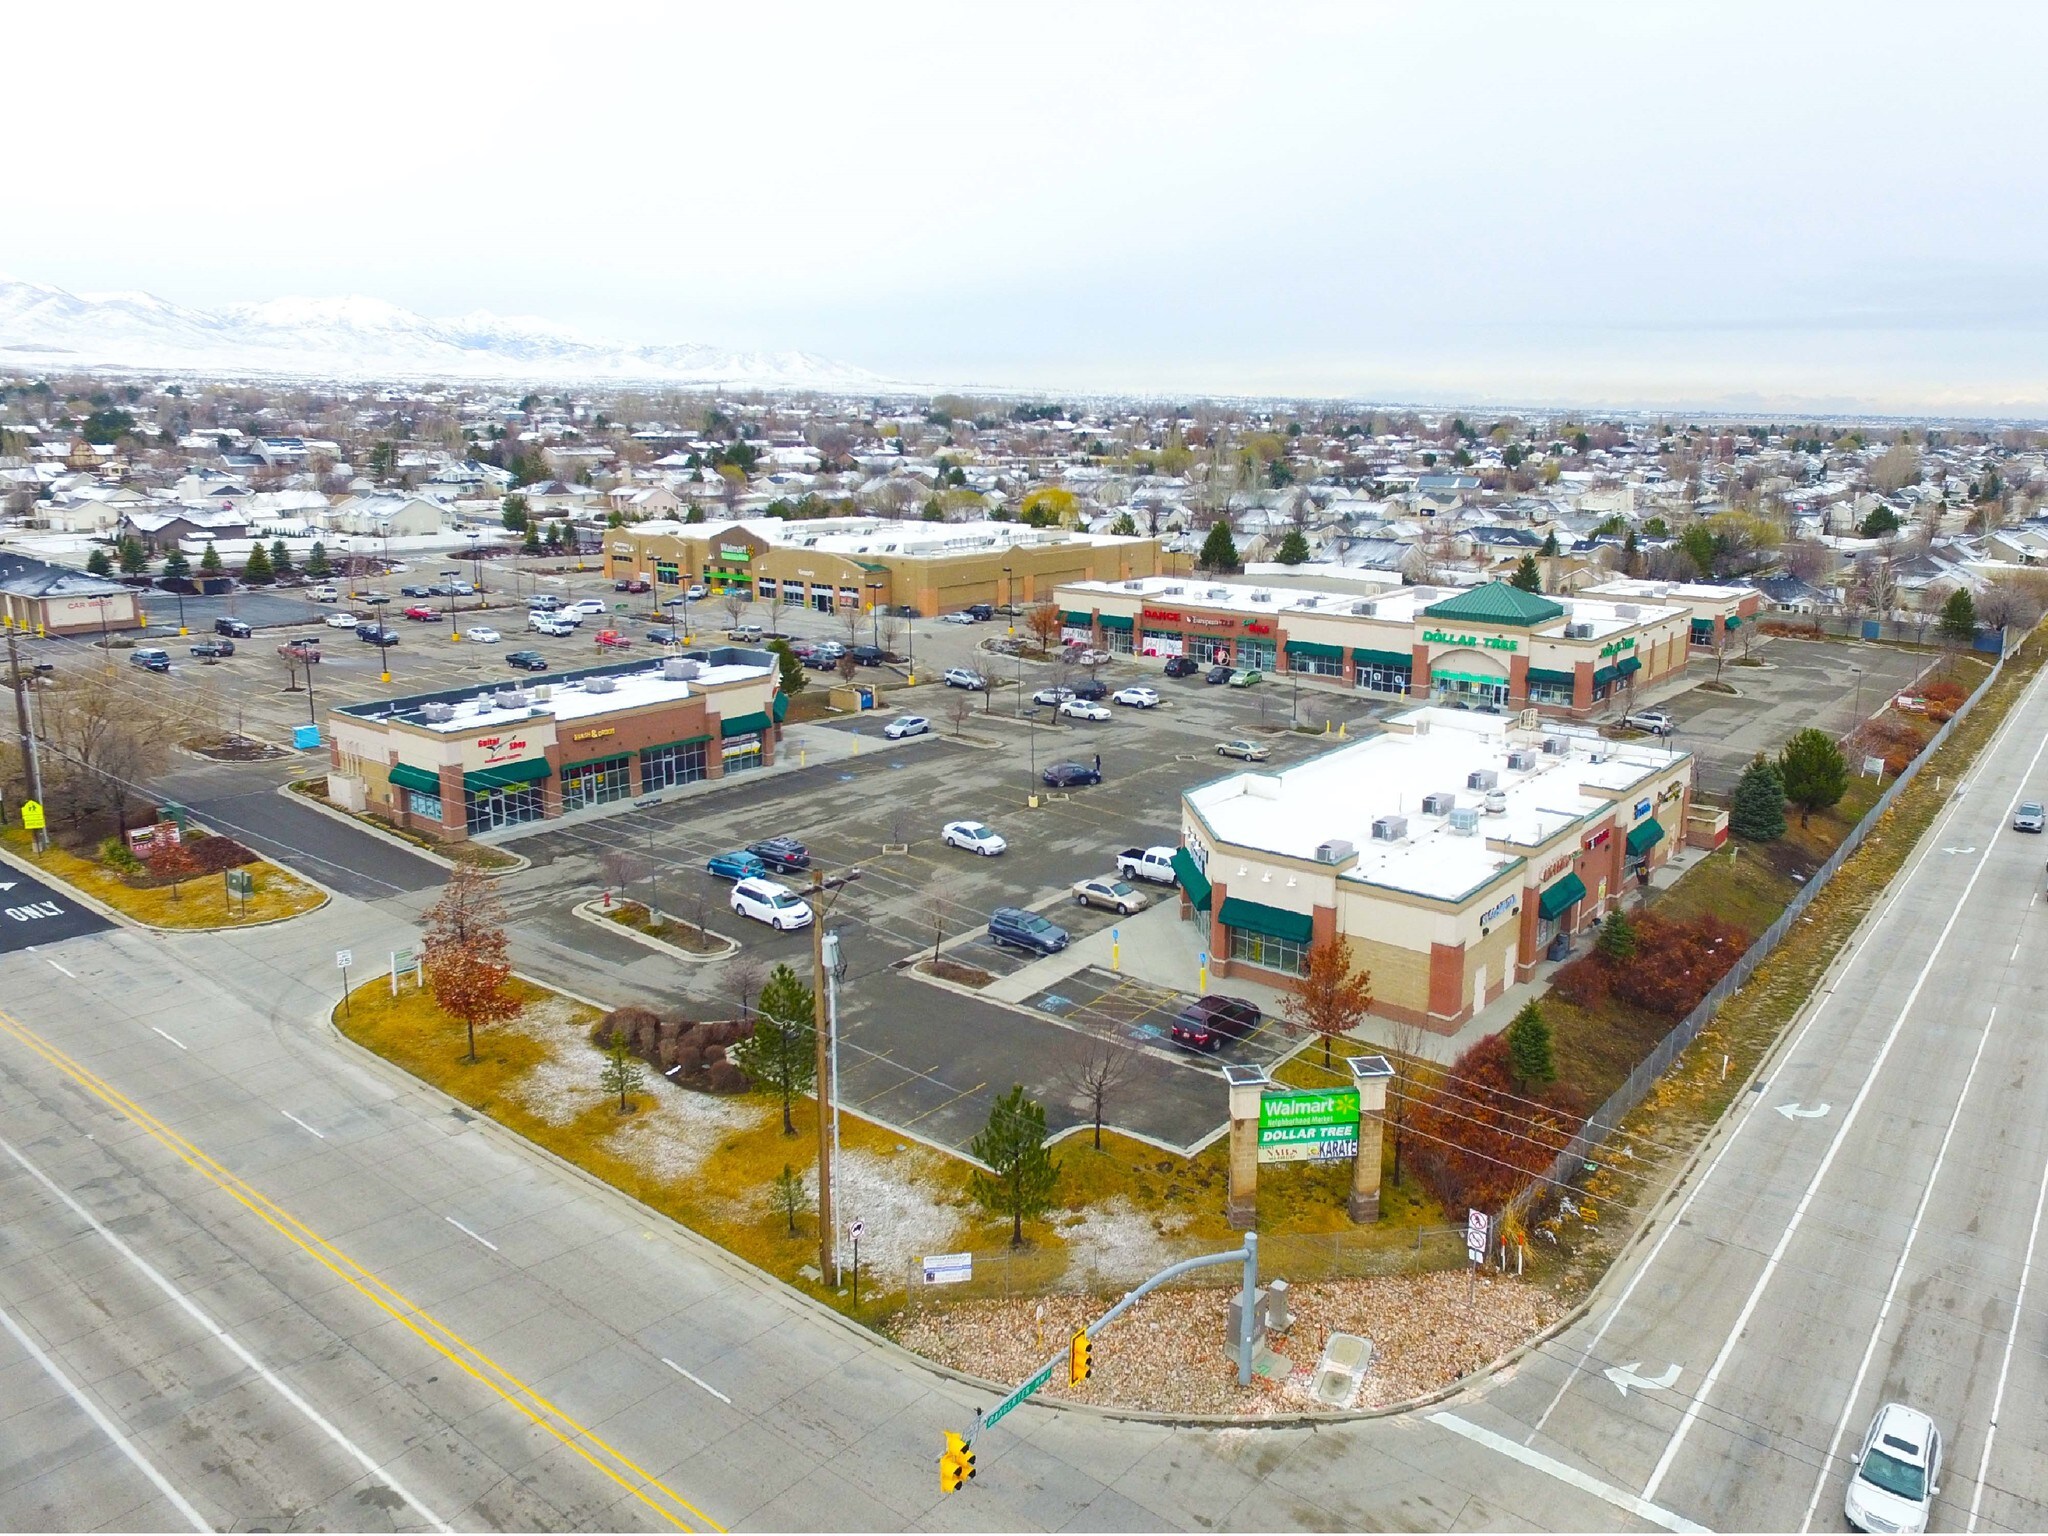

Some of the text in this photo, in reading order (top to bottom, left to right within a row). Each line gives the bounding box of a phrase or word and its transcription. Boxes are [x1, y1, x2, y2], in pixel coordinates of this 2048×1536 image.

[720, 542, 747, 554] Walmart
[1144, 609, 1180, 621] DANCE
[1192, 615, 1219, 626] European
[1422, 631, 1519, 652] DOLLAR TREE
[477, 737, 500, 748] Guitar
[509, 740, 526, 750] Shop
[4, 900, 65, 922] ONLY
[338, 957, 351, 966] 25
[1265, 1098, 1334, 1117] Walmart
[1267, 1115, 1333, 1127] Neighborhood Market
[1263, 1126, 1353, 1142] DOLLAR TREE
[1320, 1139, 1357, 1158] KARATE
[987, 1385, 1030, 1427] BANGERTER
